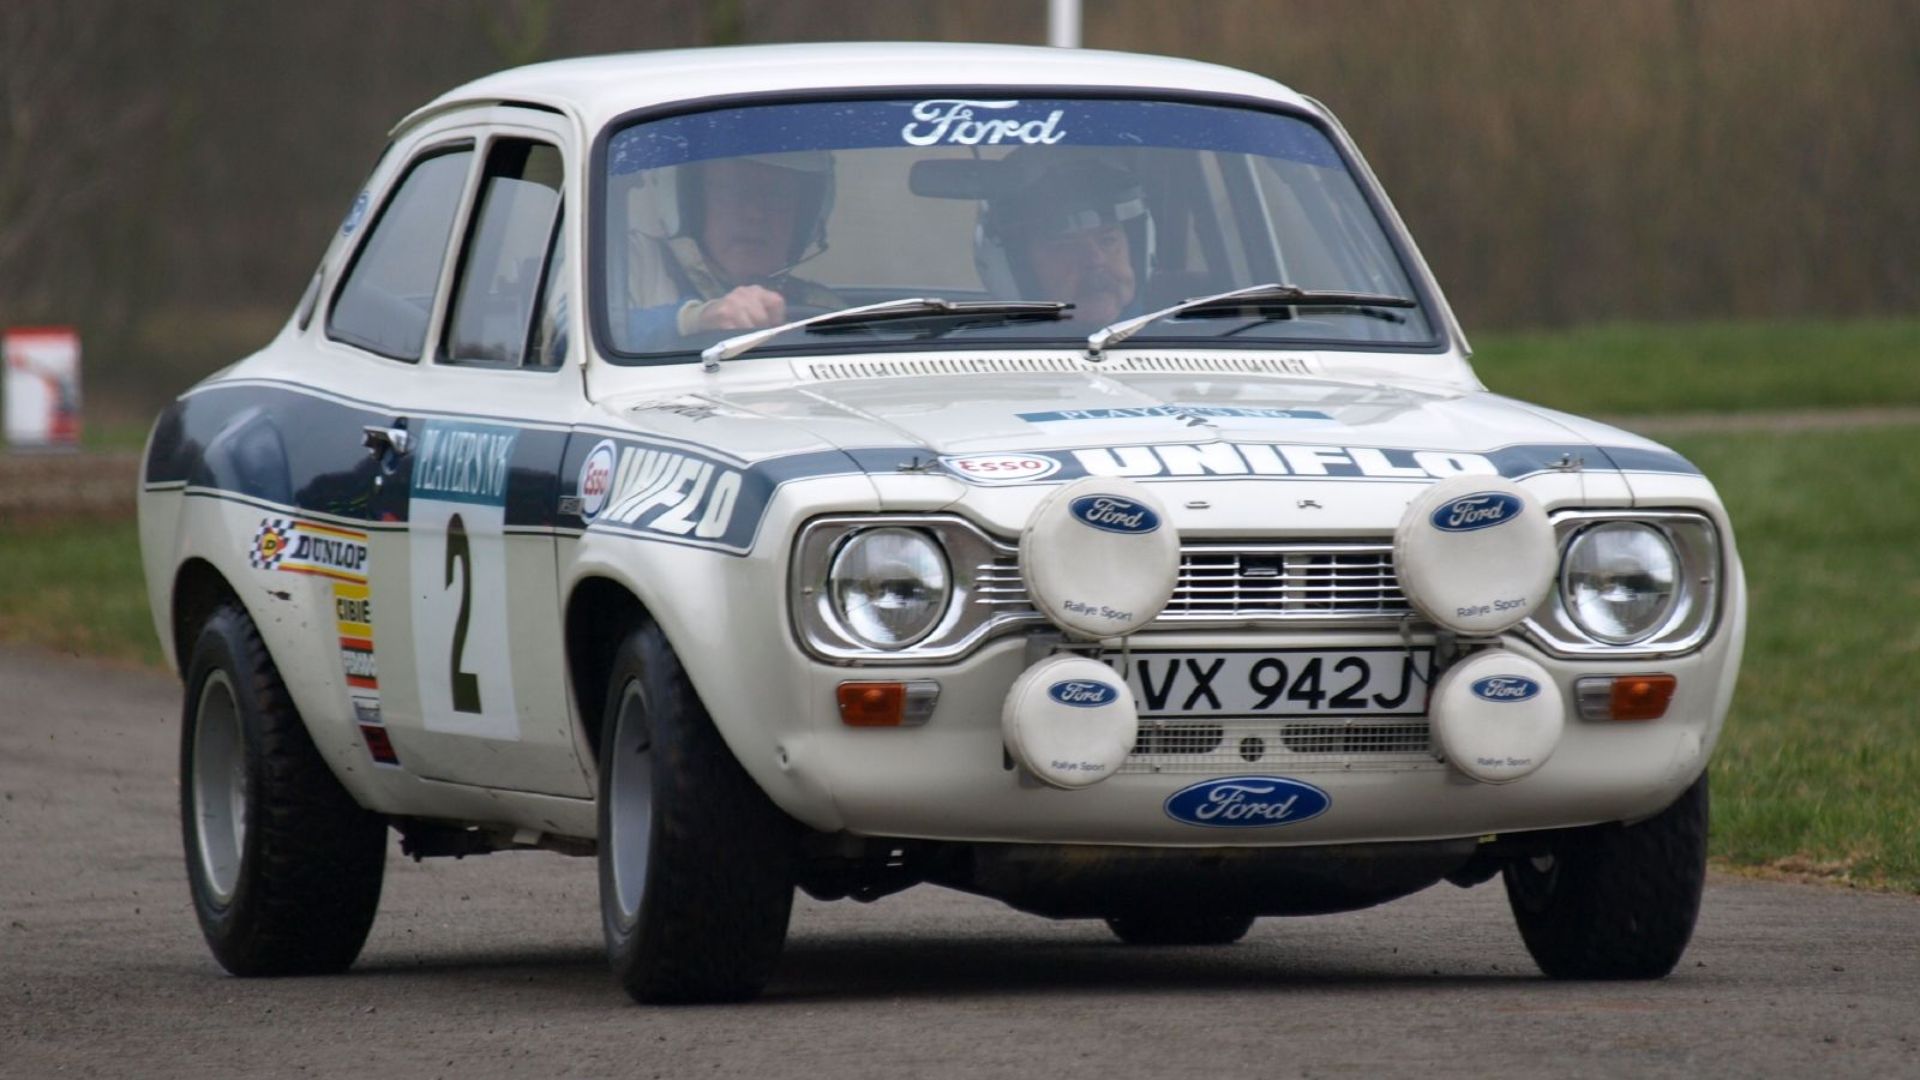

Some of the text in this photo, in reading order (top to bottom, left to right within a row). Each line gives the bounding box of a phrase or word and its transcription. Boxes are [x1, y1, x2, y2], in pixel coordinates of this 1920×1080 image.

[901, 99, 1067, 146] Ford
[1071, 443, 1499, 478] UNIFLO
[1086, 498, 1145, 528] Ford
[1449, 497, 1505, 526] Ford
[290, 535, 367, 570] DUNLOP
[444, 512, 482, 714] 2
[1063, 600, 1133, 621] Rallye Sport
[1457, 599, 1526, 618] Rallye Sport
[1061, 683, 1107, 702] Ford
[1249, 656, 1412, 710] 942J
[1484, 679, 1529, 697] Ford
[1196, 784, 1299, 820] Ford
